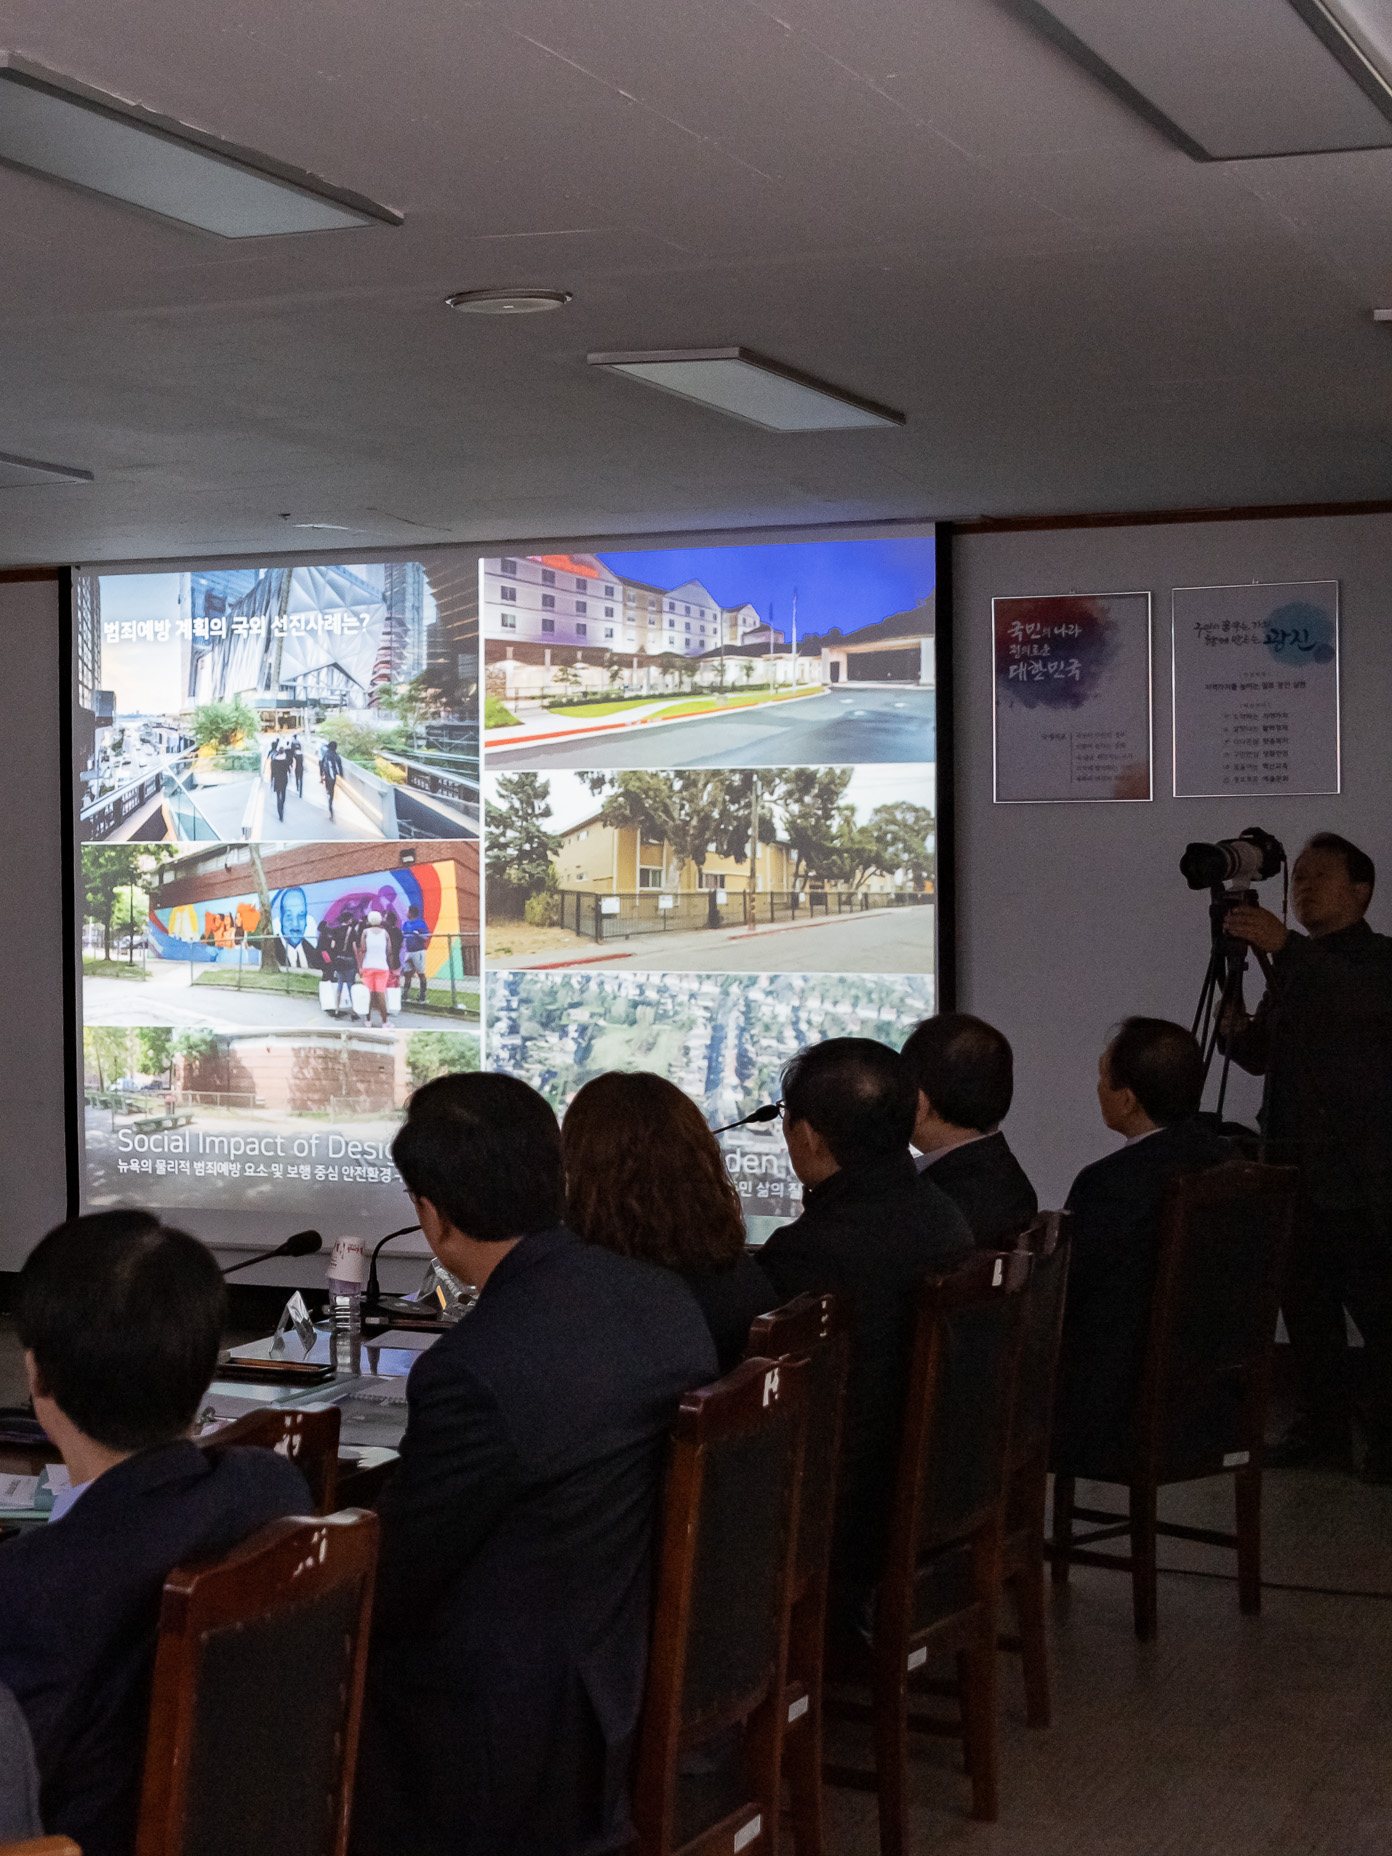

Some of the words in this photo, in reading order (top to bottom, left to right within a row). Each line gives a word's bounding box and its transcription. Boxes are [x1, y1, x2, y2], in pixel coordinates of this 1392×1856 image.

[103, 618, 171, 643] 범죄예방
[175, 616, 227, 640] 계획의
[231, 615, 266, 639] 국외
[270, 612, 371, 638] 선진사례는?
[1007, 620, 1051, 642] 국민의
[1054, 623, 1083, 638] 나라
[1009, 643, 1051, 659] 정의로운
[1263, 627, 1317, 653] 광진
[1008, 658, 1083, 681] 대한민국
[117, 1128, 189, 1155] Social
[198, 1130, 286, 1162] Impact
[293, 1134, 320, 1160] of
[117, 1158, 152, 1174] 뉴욕의
[155, 1159, 191, 1176] 물리적
[193, 1160, 242, 1178] 범죄예방
[244, 1162, 269, 1178] 요소
[271, 1162, 283, 1179] 및
[286, 1163, 311, 1180] 보행
[315, 1164, 339, 1182] 중심
[341, 1165, 392, 1184] 안전환경
[756, 1181, 785, 1198] 삶의
